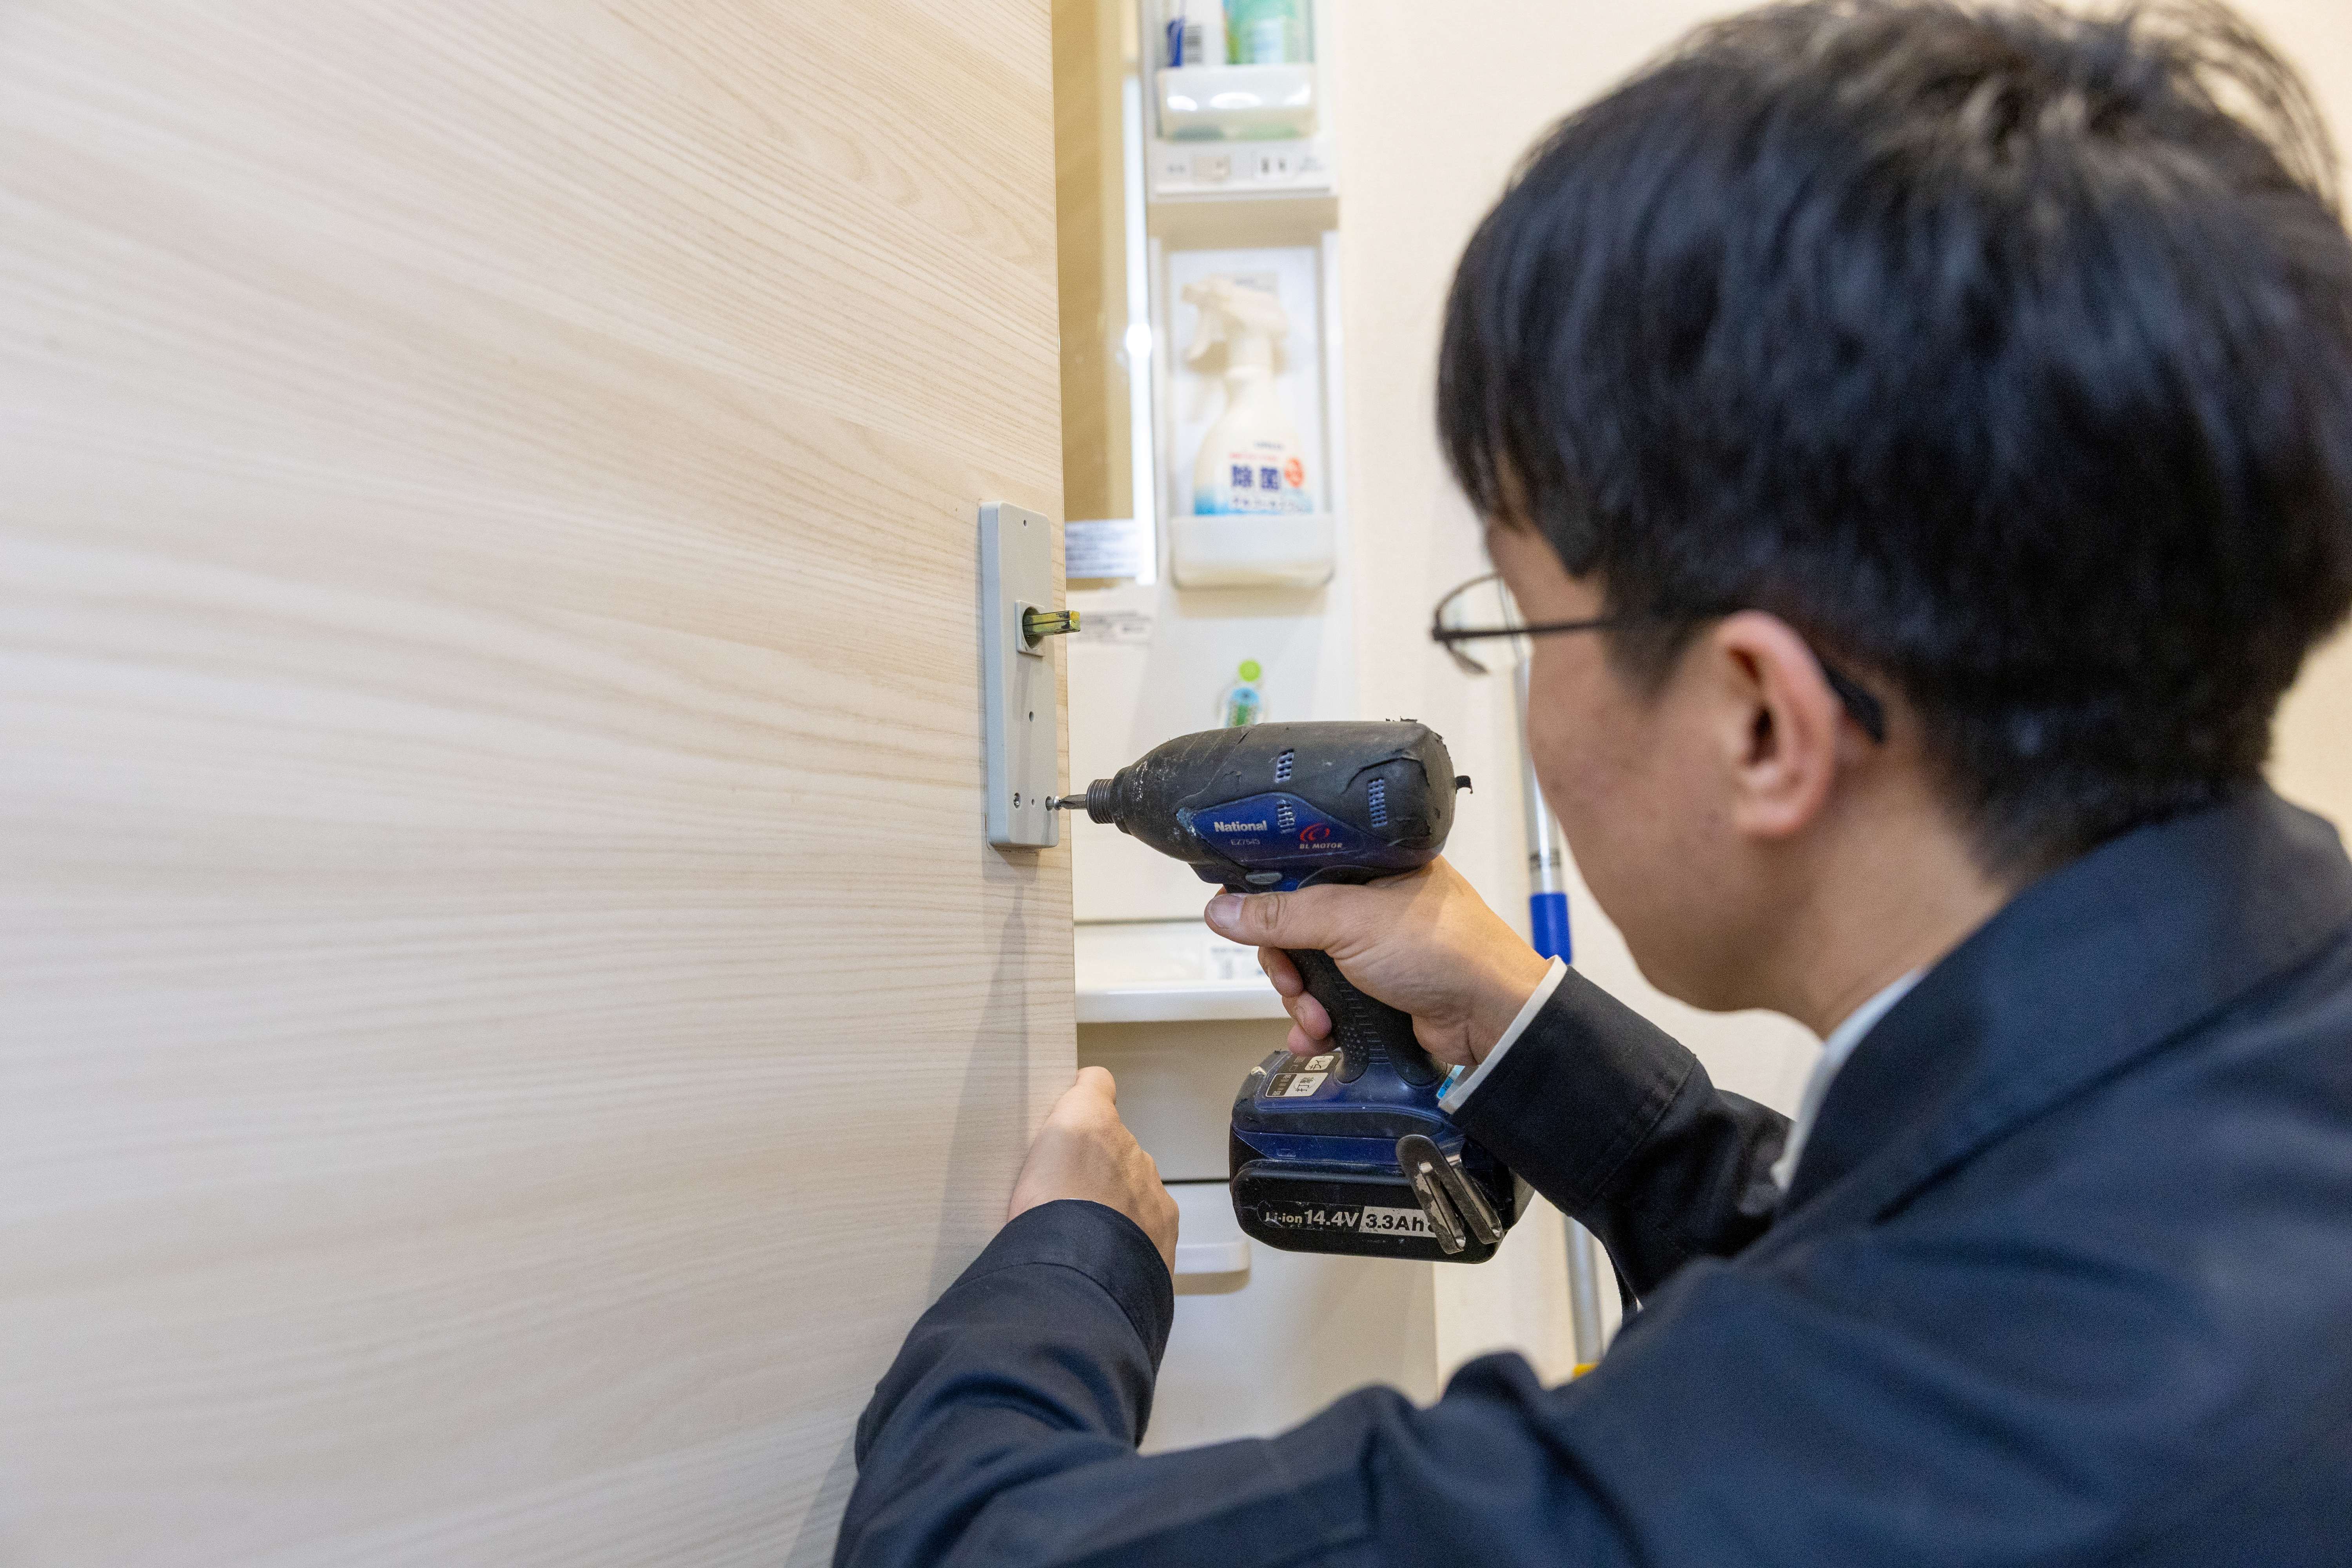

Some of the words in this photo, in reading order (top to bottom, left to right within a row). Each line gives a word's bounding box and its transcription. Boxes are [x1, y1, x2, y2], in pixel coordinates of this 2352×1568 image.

[1214, 820, 1267, 832] National
[1265, 1212, 1302, 1223] Li-ion
[1305, 1210, 1359, 1227] 14.4V
[1366, 1214, 1424, 1231] 3.3Ah
